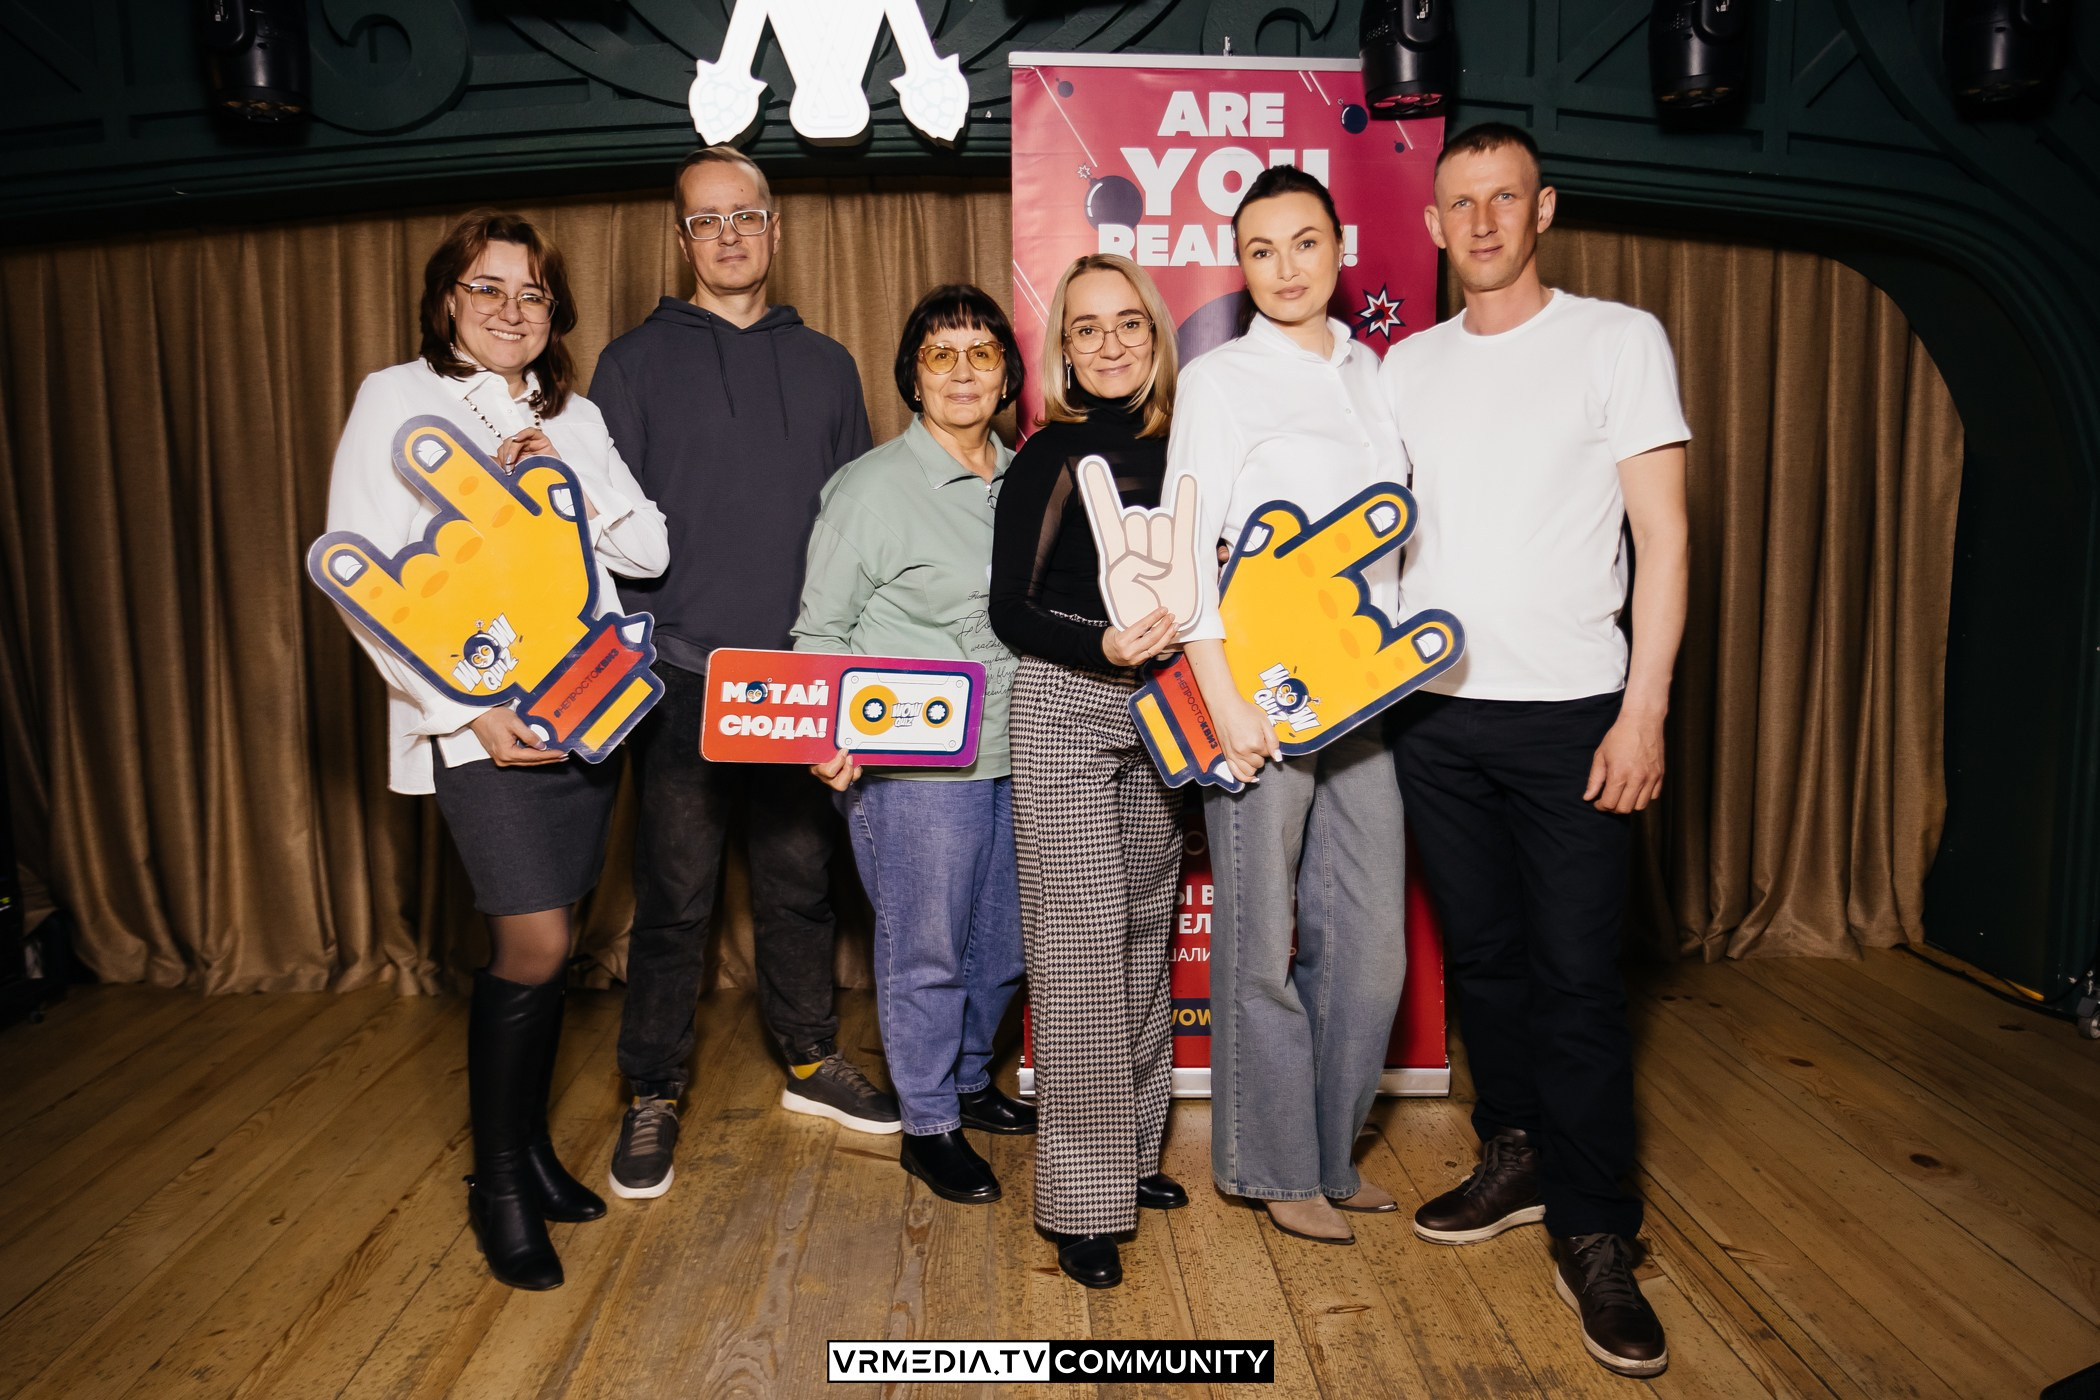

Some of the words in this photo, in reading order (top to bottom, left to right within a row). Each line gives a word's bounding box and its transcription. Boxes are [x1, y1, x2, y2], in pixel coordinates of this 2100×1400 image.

[1157, 91, 1285, 138] ARE
[482, 647, 519, 691] QUIZ
[891, 702, 923, 719] WOW
[719, 714, 828, 740] СЮДА!
[894, 717, 914, 727] QUIZ
[1178, 913, 1212, 934] ЕЛ
[1172, 1008, 1211, 1026] OW
